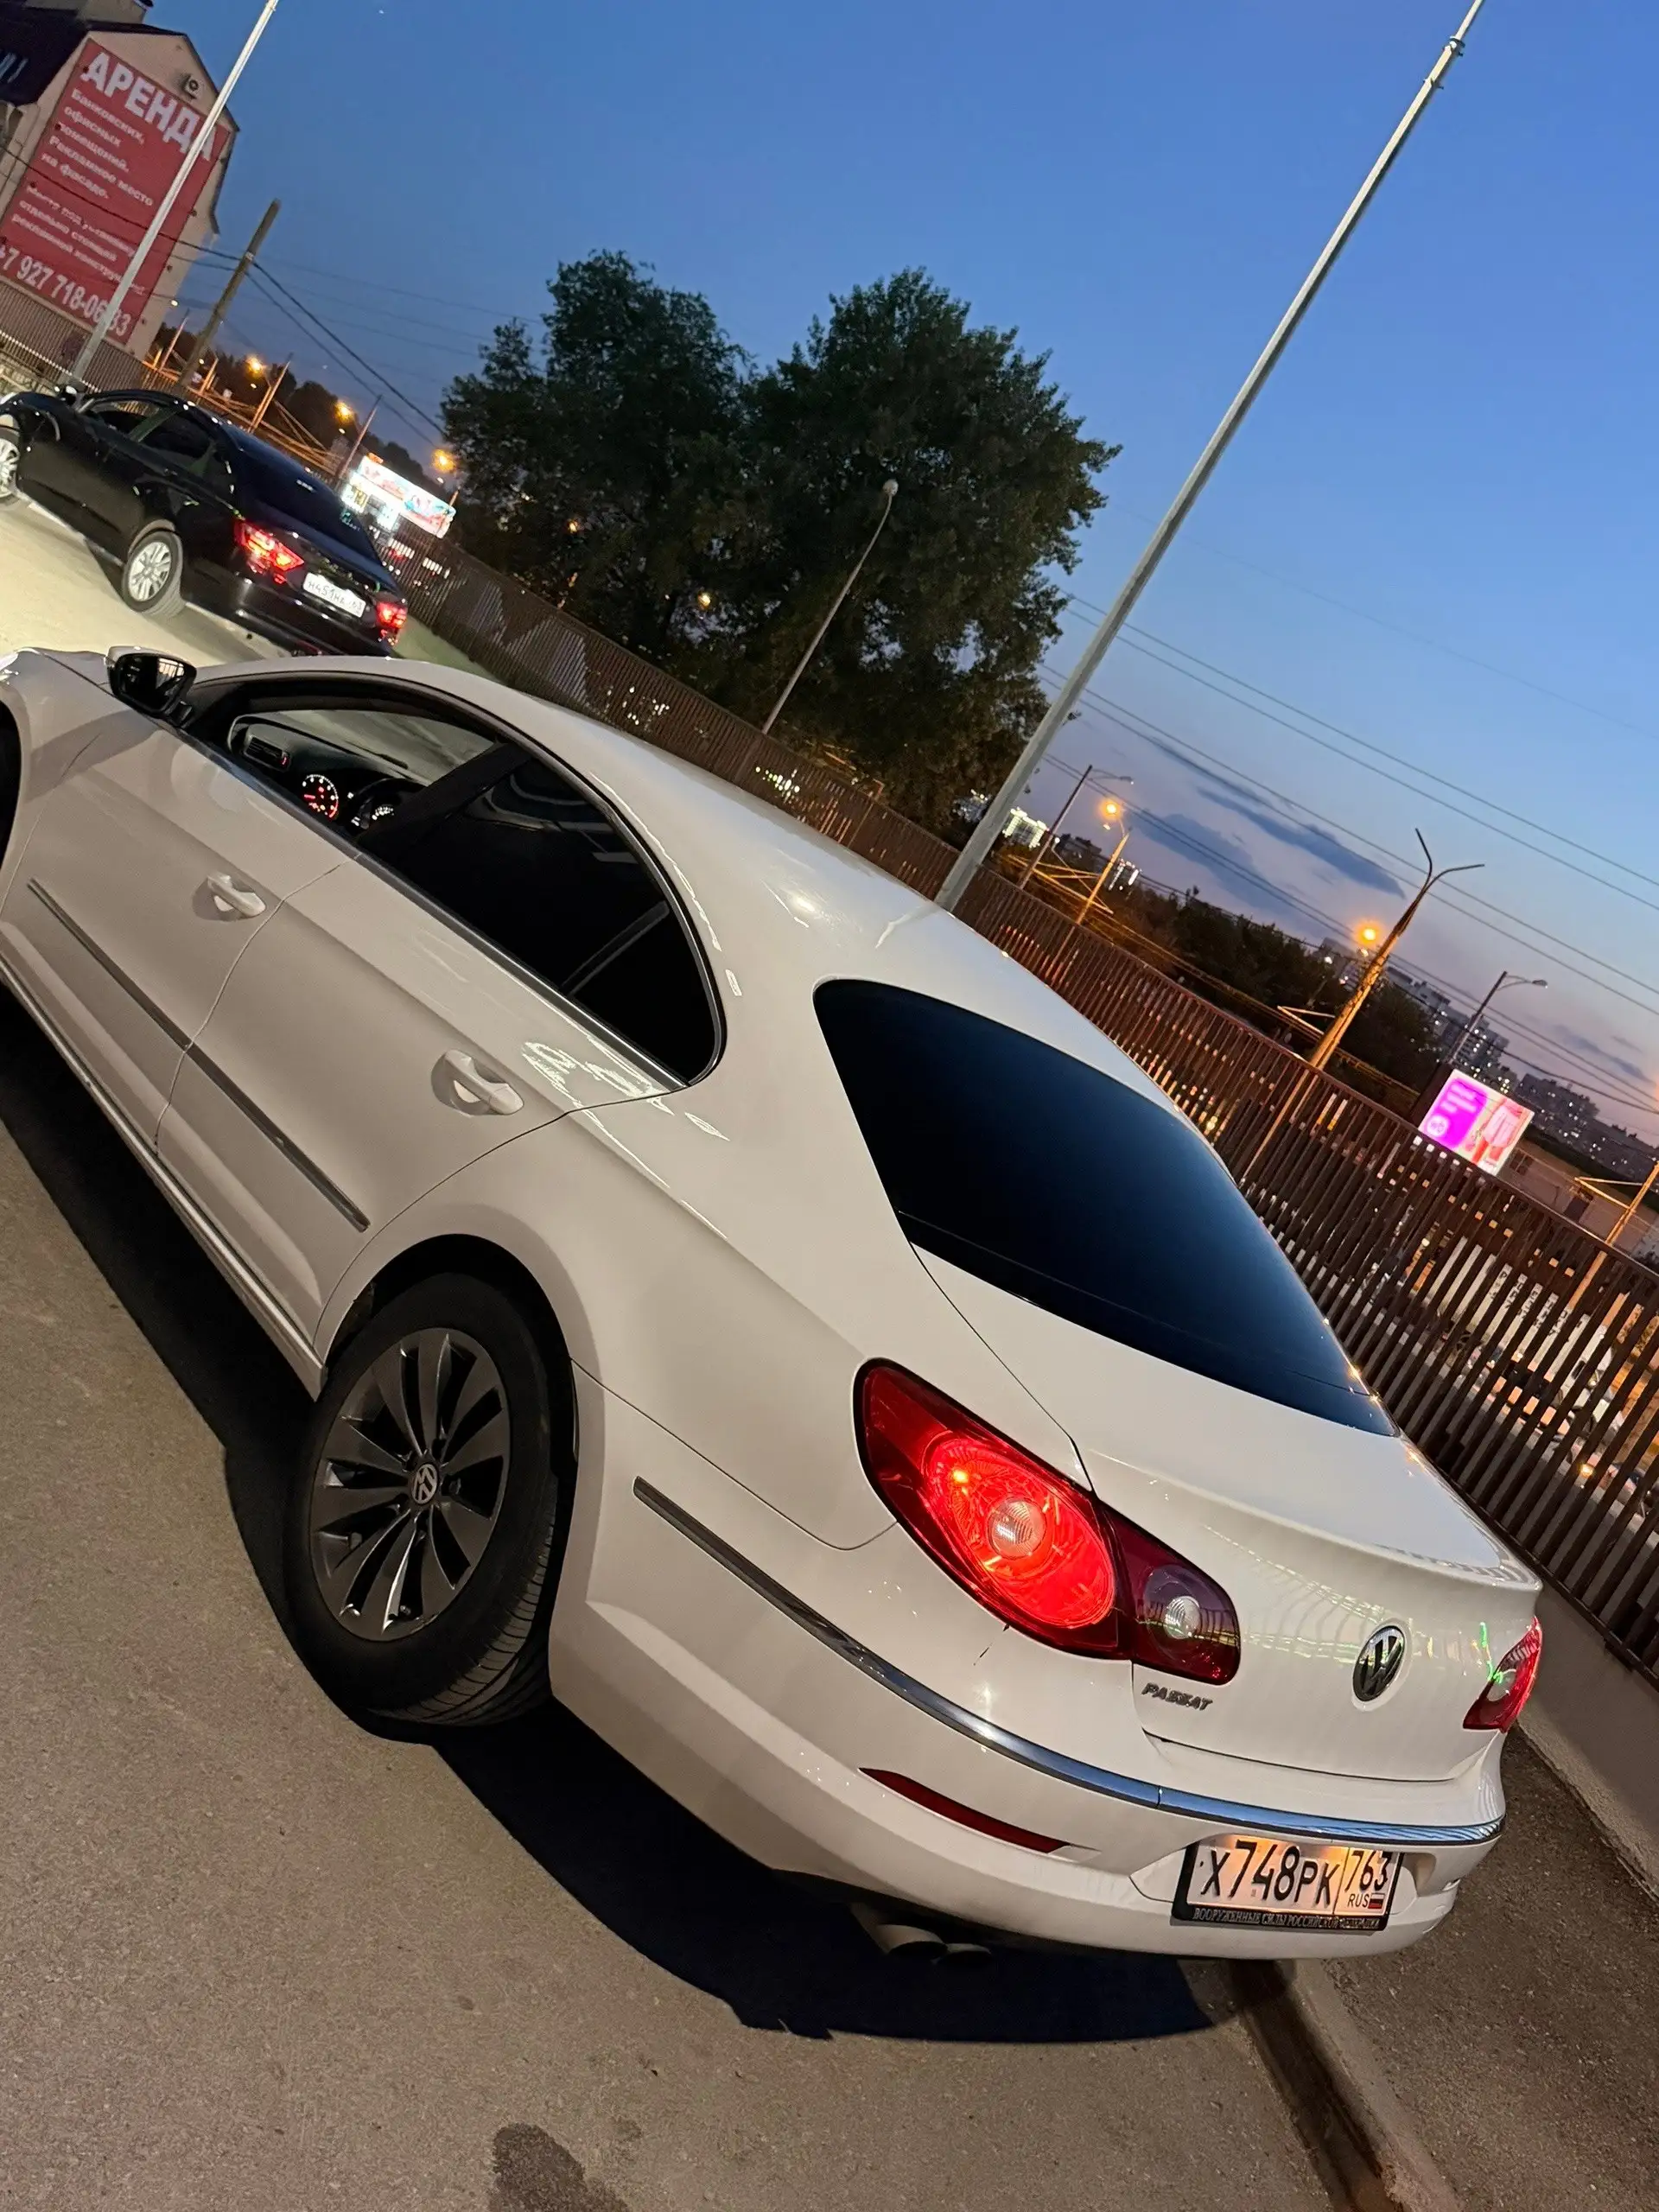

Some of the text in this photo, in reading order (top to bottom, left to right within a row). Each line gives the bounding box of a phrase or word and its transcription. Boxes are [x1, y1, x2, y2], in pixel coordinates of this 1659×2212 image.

[16, 256, 54, 290] 927
[1141, 1682, 1213, 1711] PASSAT
[1344, 1850, 1393, 1892] 763
[1347, 1892, 1370, 1909] RUS
[1262, 1913, 1287, 1926] СИЛЫ
